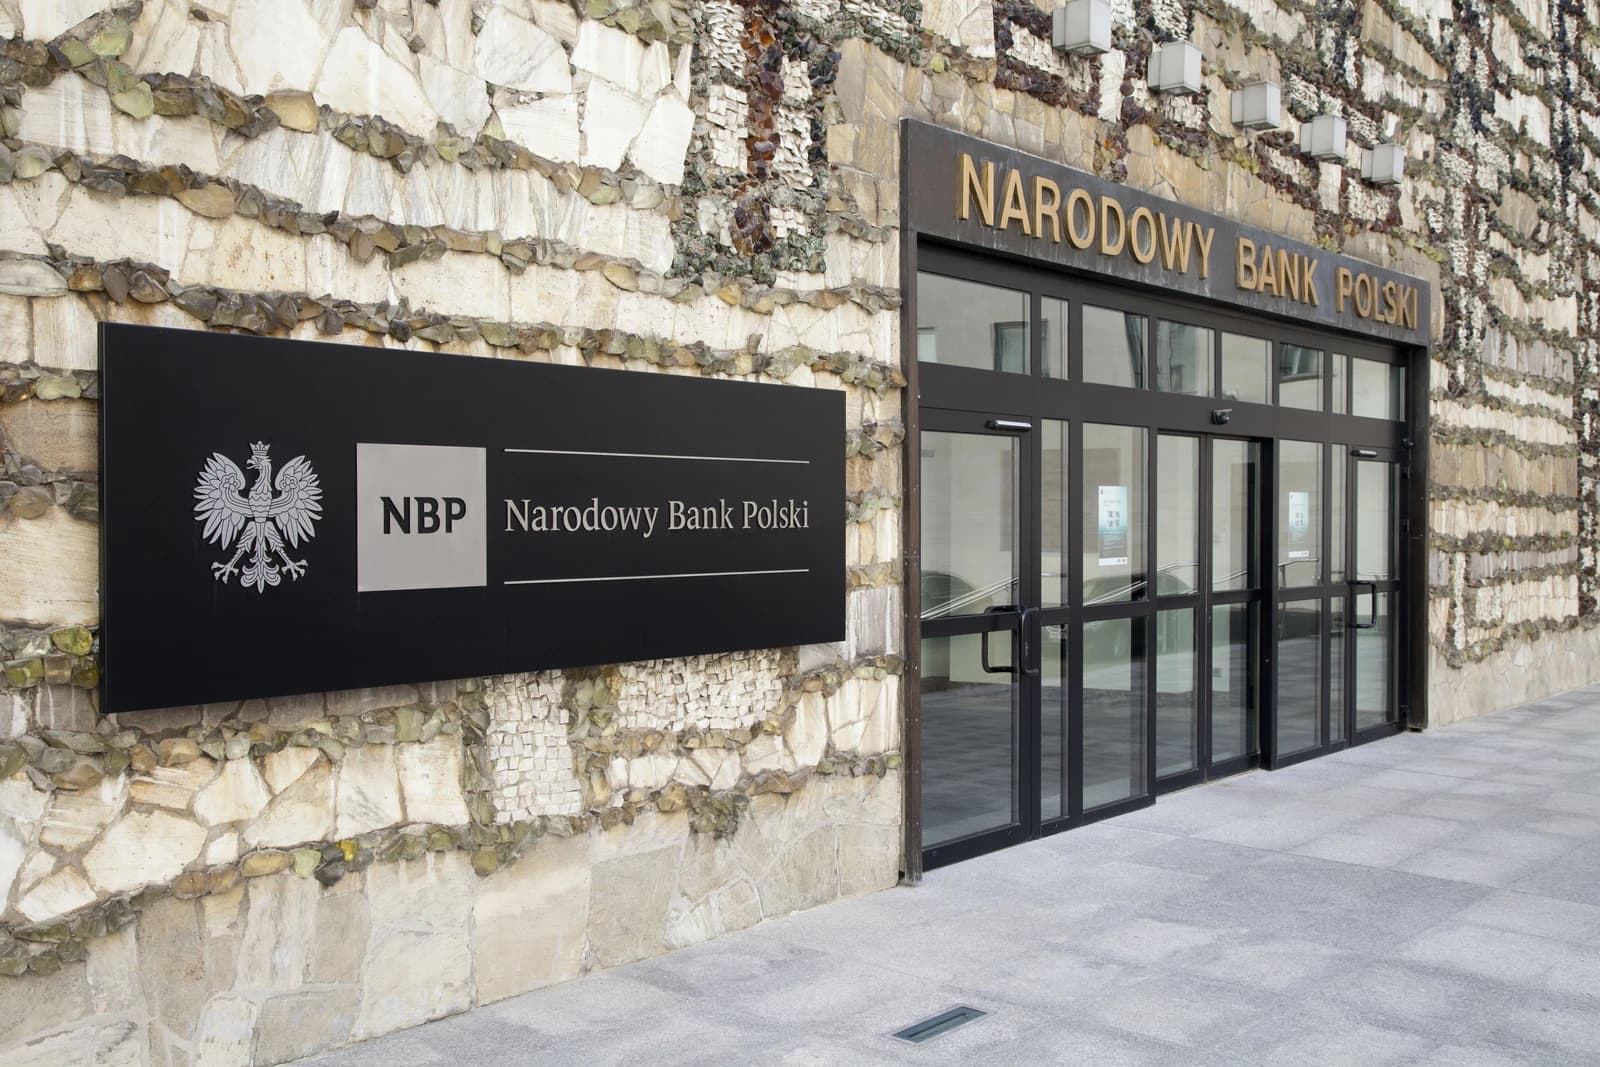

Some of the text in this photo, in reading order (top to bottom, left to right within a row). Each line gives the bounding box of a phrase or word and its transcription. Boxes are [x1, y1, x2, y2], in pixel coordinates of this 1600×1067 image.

[958, 152, 1418, 330] NARODOWY BANK POLSKI
[380, 496, 467, 535] NBP
[504, 497, 810, 538] Narodowy Bank Polski
